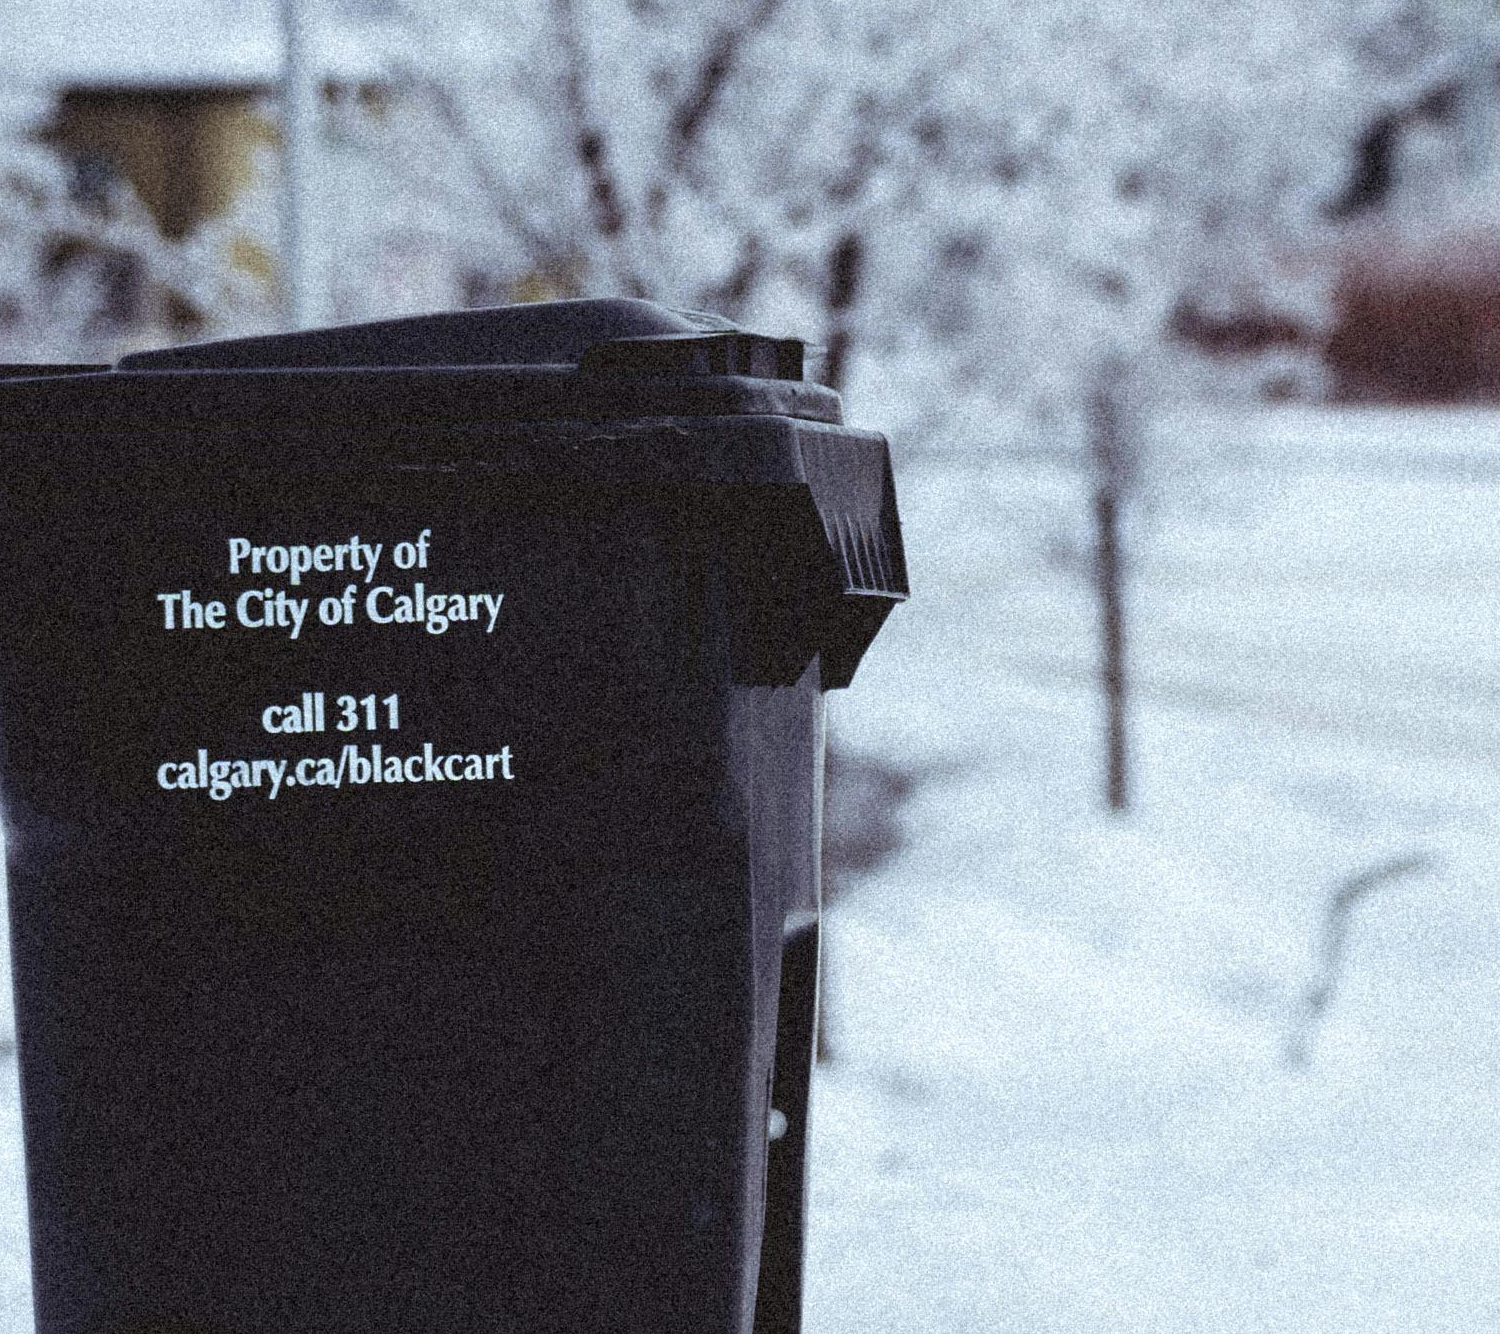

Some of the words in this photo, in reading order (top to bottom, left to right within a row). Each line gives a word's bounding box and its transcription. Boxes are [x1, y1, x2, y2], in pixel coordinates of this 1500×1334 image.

[229, 536, 383, 585] Property
[393, 529, 431, 569] of
[157, 590, 226, 629] The
[236, 586, 308, 639] City
[319, 584, 357, 625] of
[365, 582, 504, 634] Calgary
[262, 692, 325, 733] call
[337, 694, 398, 731] 311
[157, 743, 514, 800] calgary.ca/blackcart
